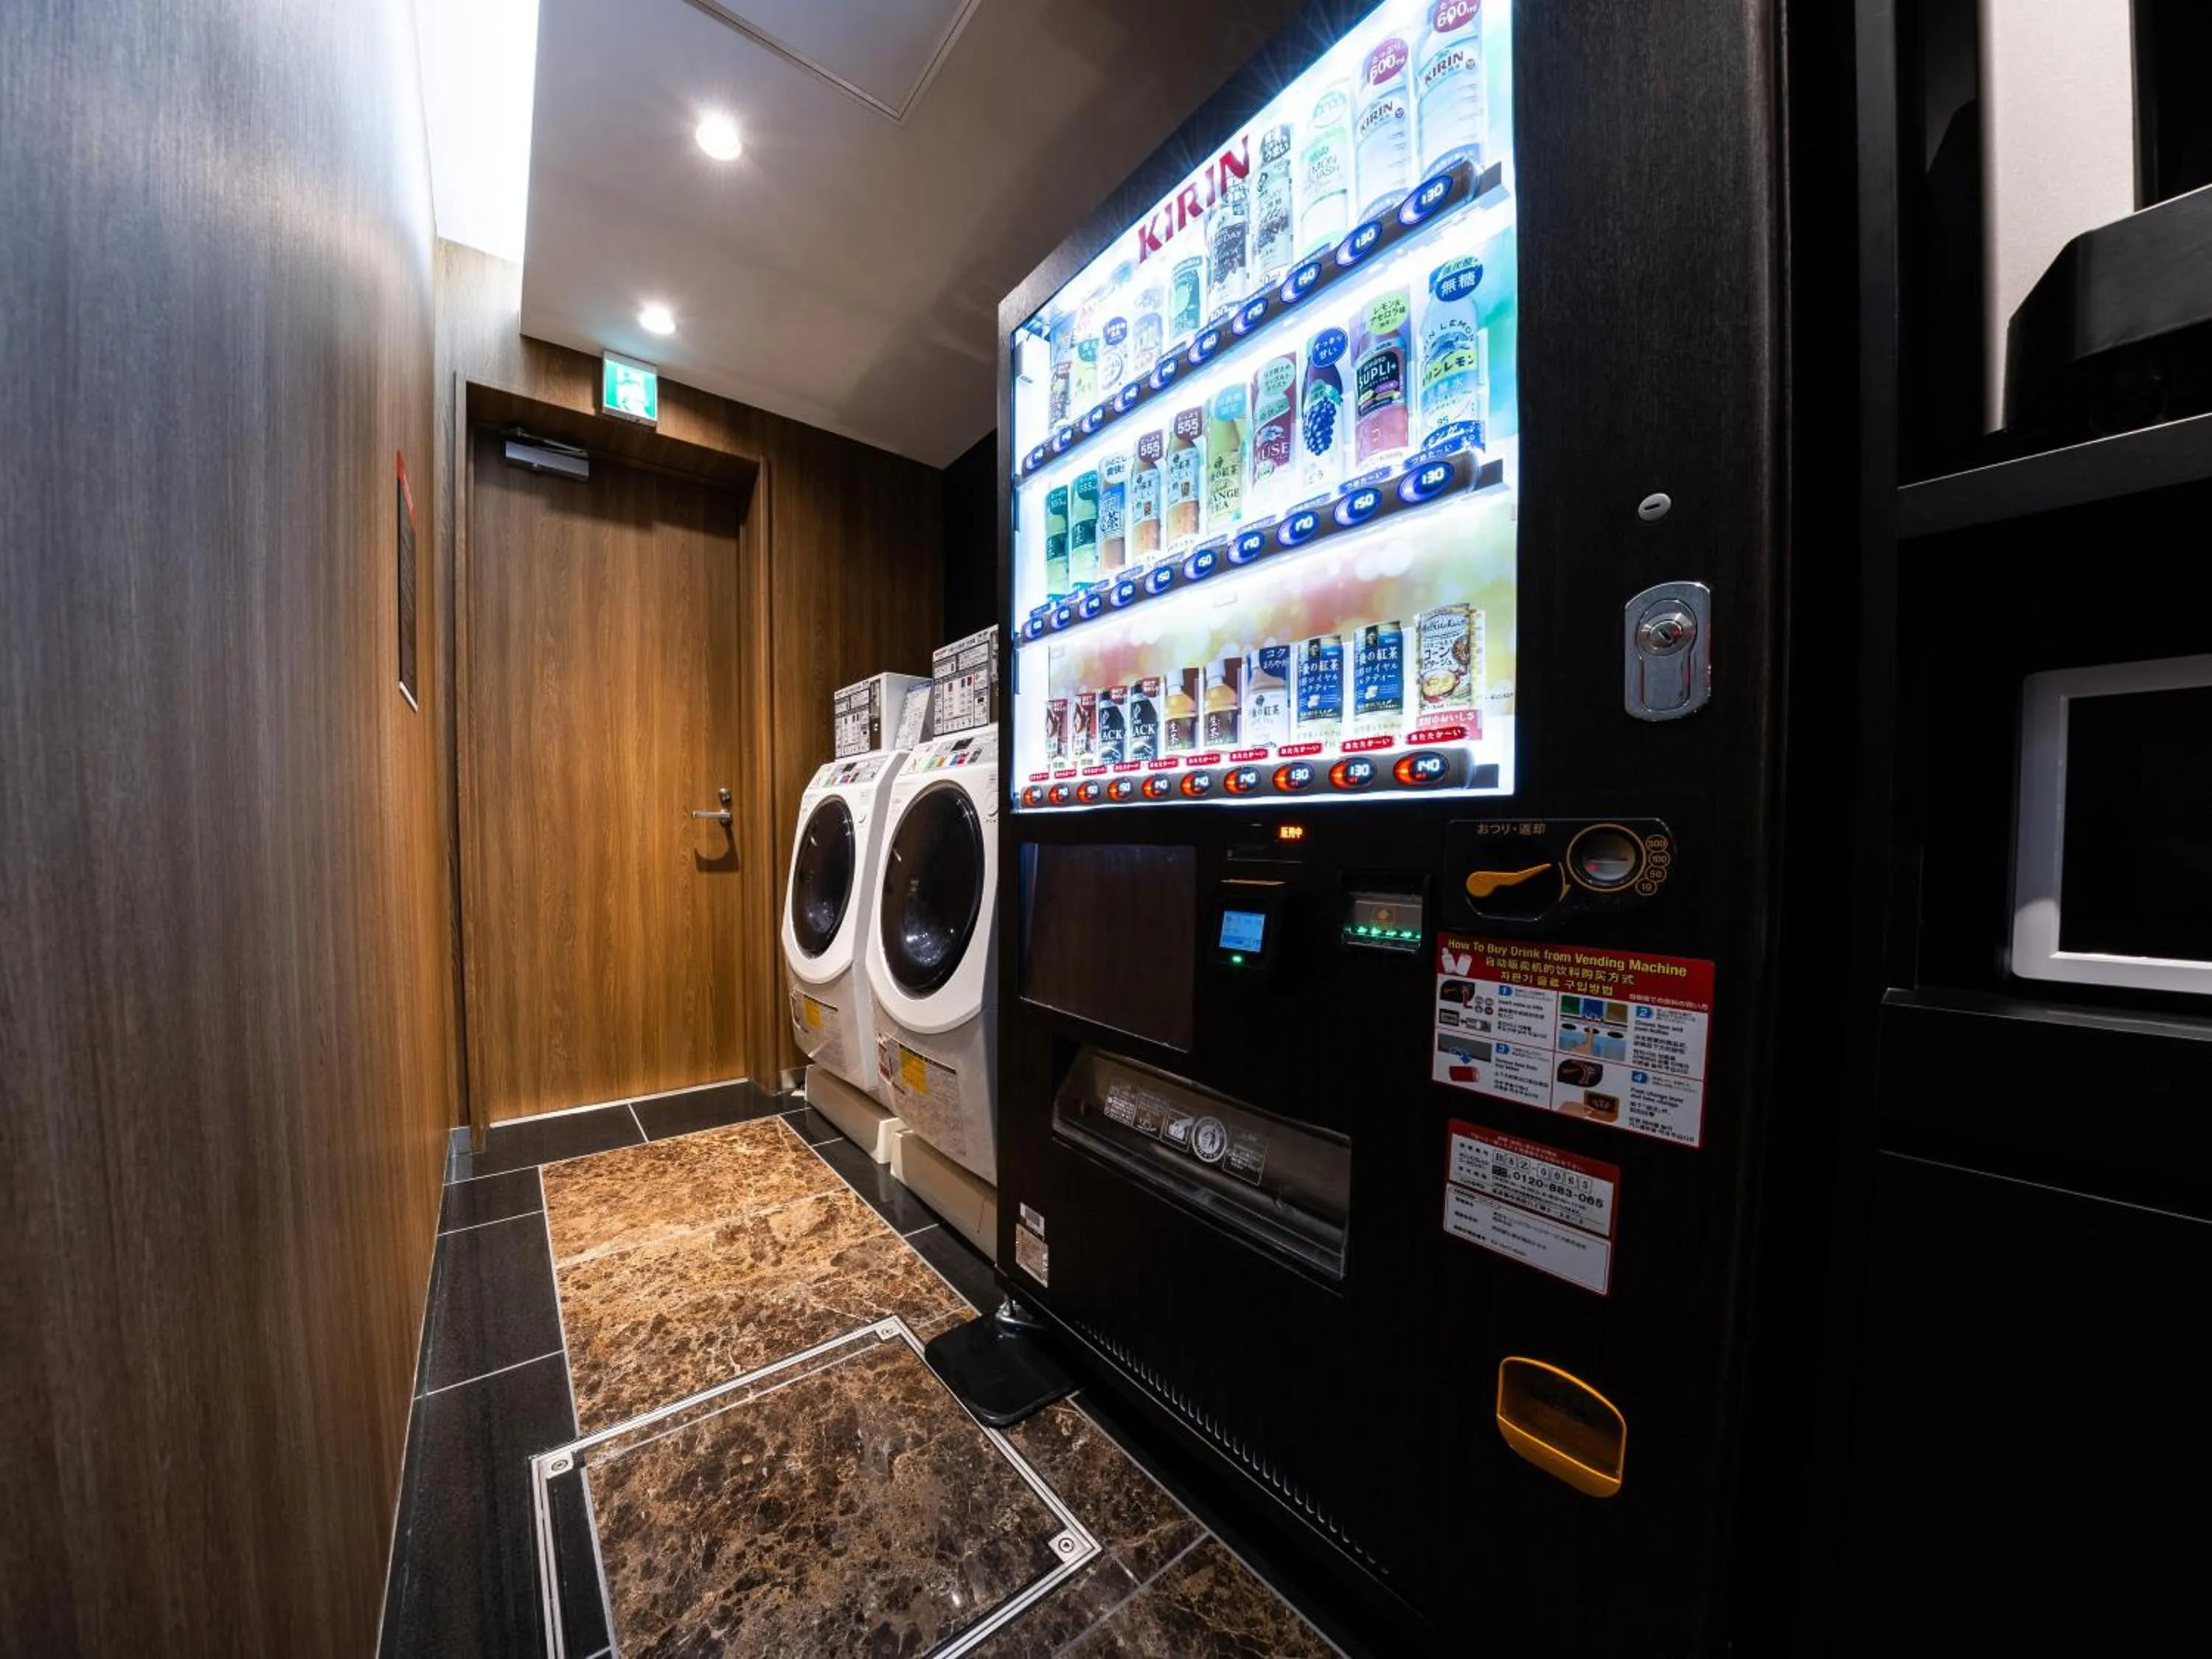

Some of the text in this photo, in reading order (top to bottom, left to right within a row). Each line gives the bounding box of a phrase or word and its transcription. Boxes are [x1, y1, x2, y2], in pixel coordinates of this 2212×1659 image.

[1425, 50, 1464, 85] KIRIN
[1360, 100, 1394, 131] KIRIN
[1138, 135, 1251, 263] KIRIN
[1422, 183, 1444, 206] 130
[1354, 227, 1375, 248] 130
[1441, 271, 1475, 296] 無糖
[1318, 347, 1338, 360] 甘い
[1178, 418, 1200, 435] 555
[1422, 467, 1445, 485] 130
[1353, 493, 1375, 510] 150
[1266, 648, 1287, 659] コク
[1411, 728, 1462, 742] あたたか〜い
[1344, 738, 1391, 751] あたたか〜い
[1350, 764, 1370, 777] 130
[1416, 758, 1441, 773] 140
[1290, 768, 1310, 781] 130
[1475, 822, 1547, 836] おつり・返却
[1647, 839, 1668, 849] 500
[1652, 855, 1668, 864] 100
[1649, 870, 1663, 879] 50
[1640, 883, 1652, 892] 10
[1448, 938, 1688, 978] How To Buy Drink from Vending Machine
[1638, 1008, 1649, 1018] 2
[1513, 1171, 1604, 1208] 0120-883-065
